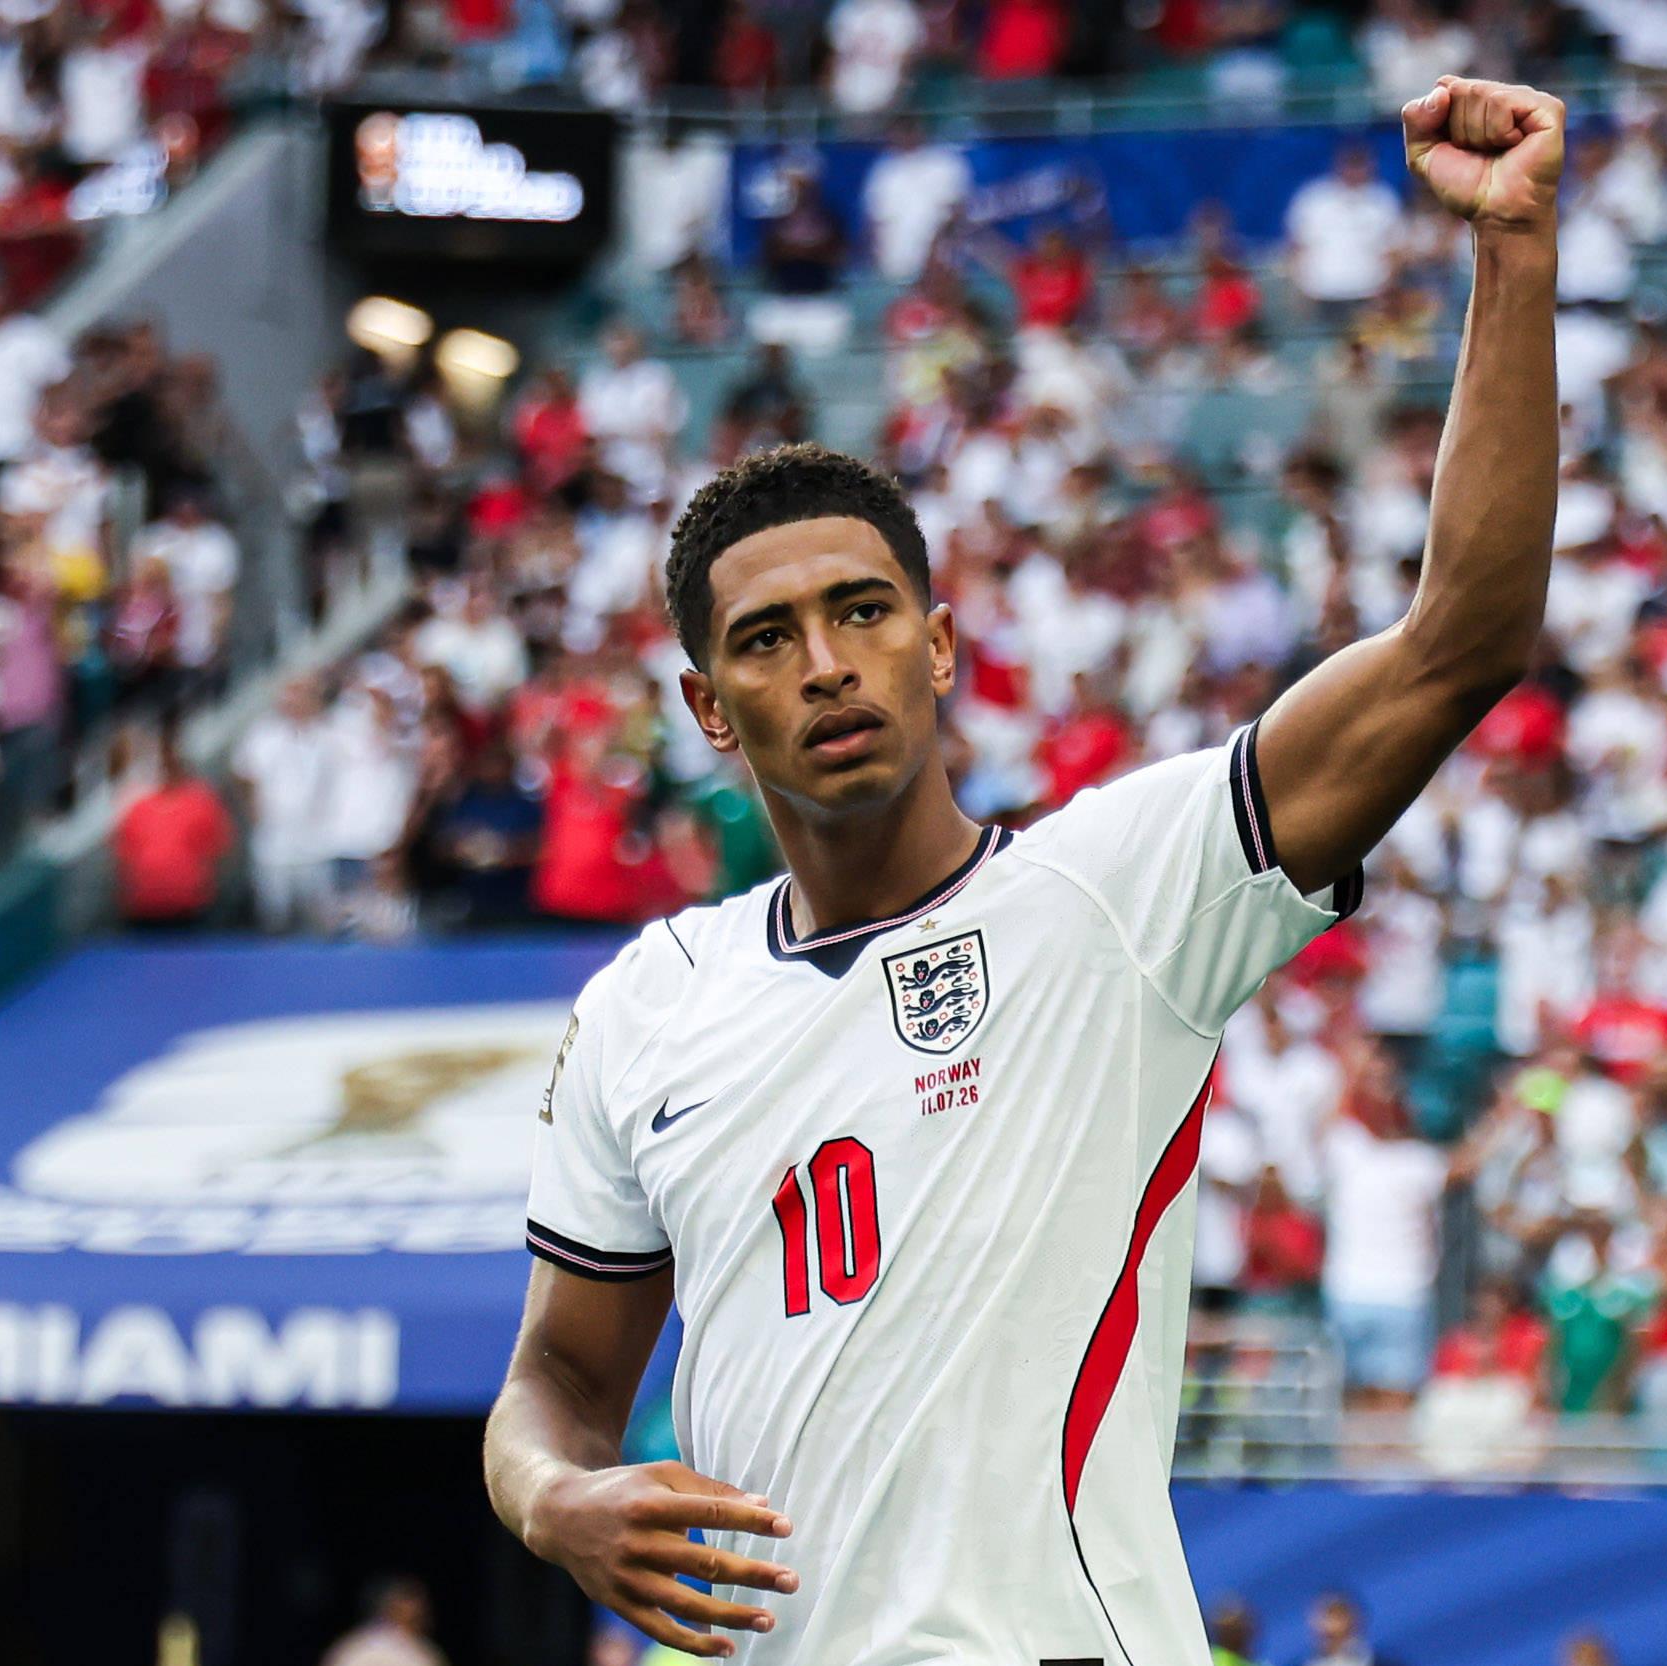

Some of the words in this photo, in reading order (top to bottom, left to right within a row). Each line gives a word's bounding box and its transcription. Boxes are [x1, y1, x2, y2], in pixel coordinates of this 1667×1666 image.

[914, 1057, 981, 1095] NORWAY
[921, 1084, 979, 1117] 11.07.26
[772, 1136, 882, 1319] 10
